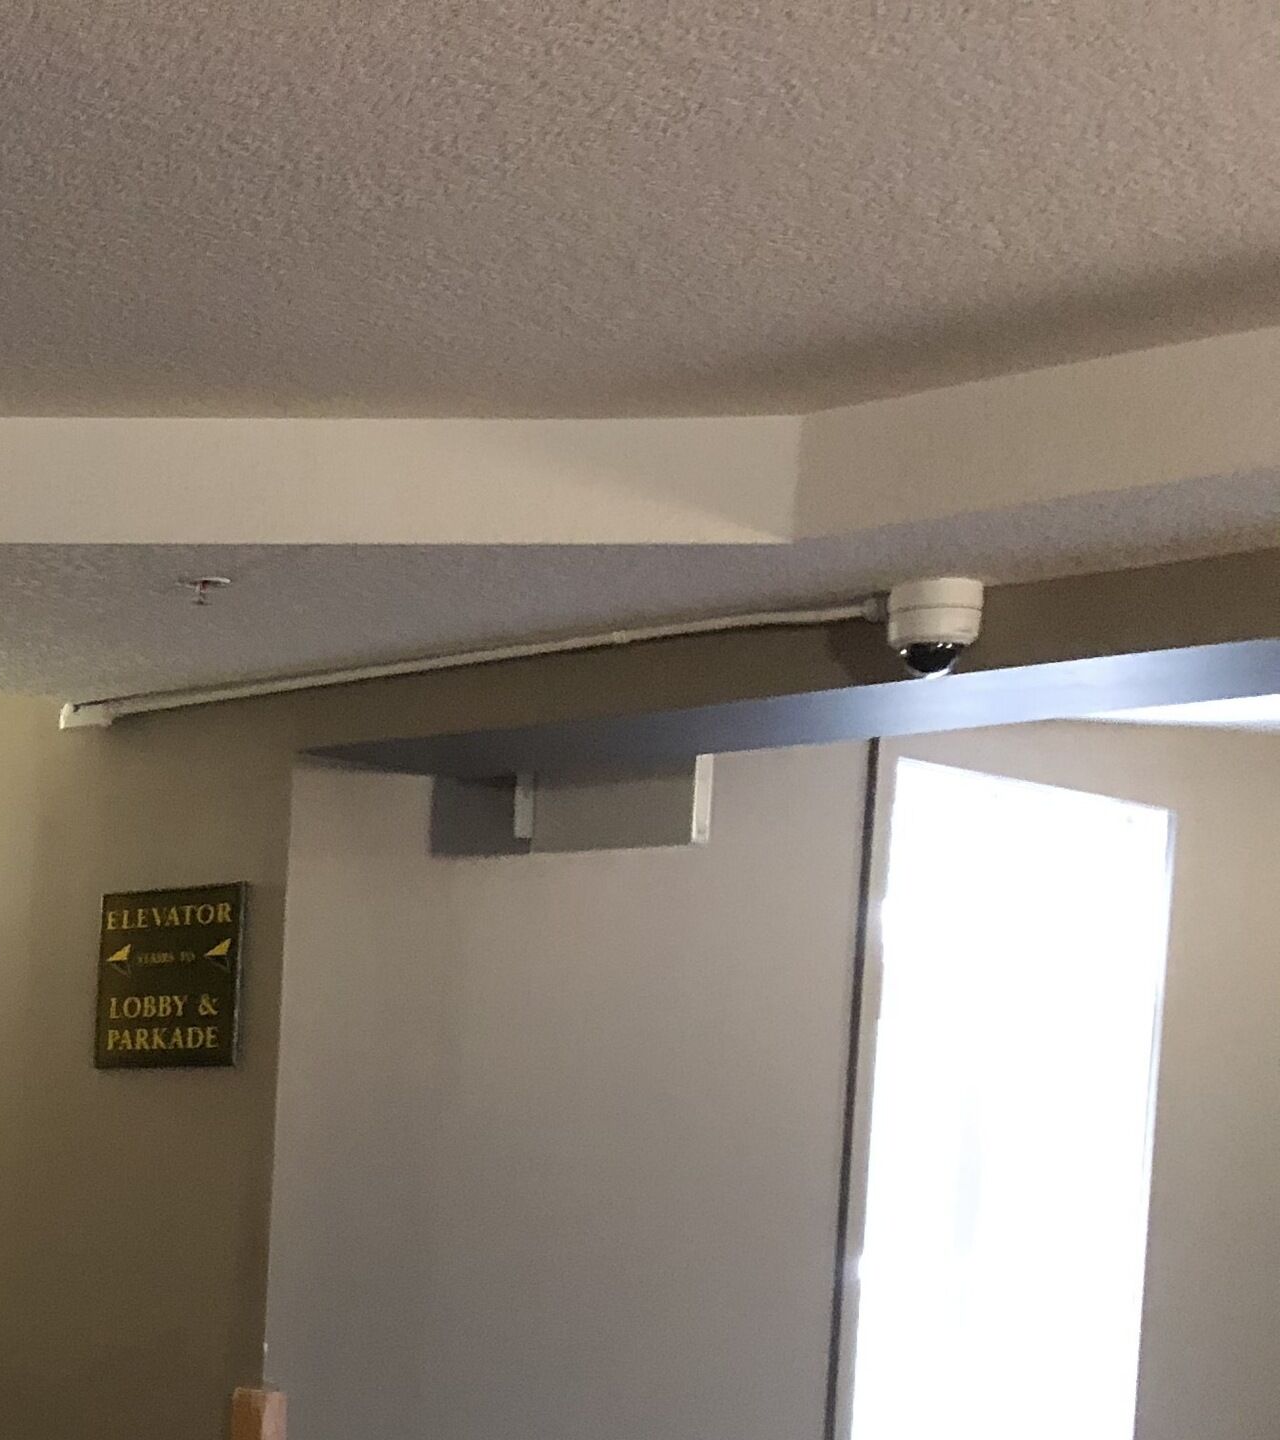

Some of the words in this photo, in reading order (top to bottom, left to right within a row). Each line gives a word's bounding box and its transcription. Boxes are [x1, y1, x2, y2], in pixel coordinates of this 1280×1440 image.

[106, 902, 233, 930] ELEVATOR
[109, 994, 189, 1019] LOBBY
[197, 993, 220, 1016] &
[107, 1026, 220, 1051] PARKADE
